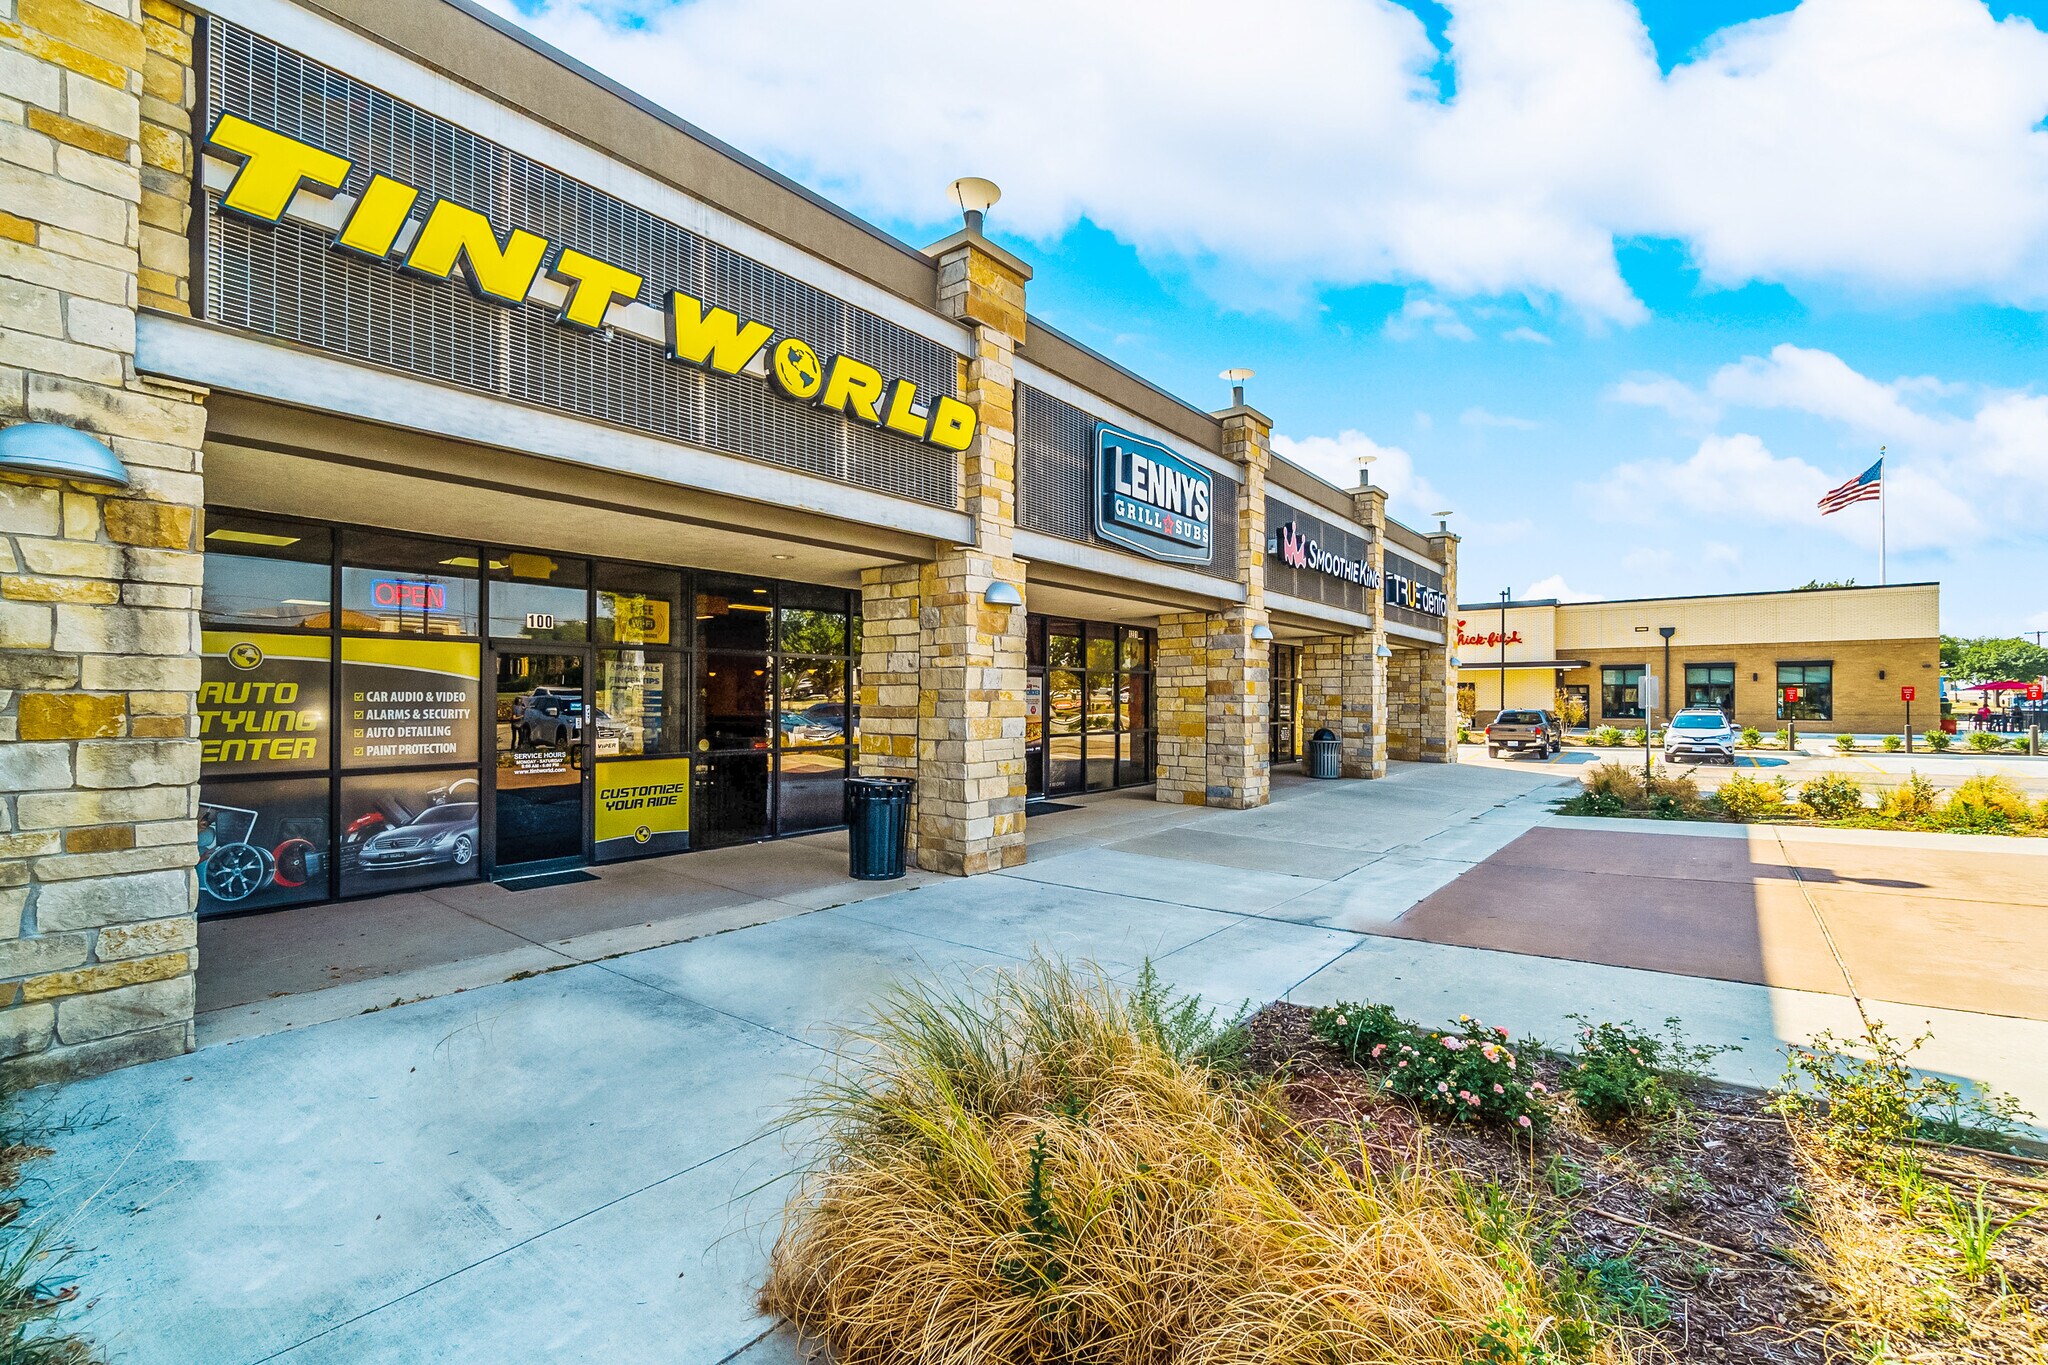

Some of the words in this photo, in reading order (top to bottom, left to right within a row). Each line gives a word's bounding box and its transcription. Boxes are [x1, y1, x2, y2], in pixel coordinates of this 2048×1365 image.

[204, 110, 645, 333] TINT
[668, 289, 977, 451] WORLD
[1115, 446, 1209, 522] LENNYS
[1115, 499, 1162, 529] GRILL
[1175, 520, 1208, 543] SUBS
[1308, 540, 1359, 583] SMOOTHIE
[376, 583, 443, 608] OPEN
[1394, 574, 1421, 609] TRUE
[528, 615, 552, 628] 100
[1457, 620, 1522, 647] hick-fil-A
[198, 682, 298, 704] AUTO
[366, 691, 388, 702] CAR
[390, 691, 423, 702] AUDIO
[426, 691, 434, 702] &
[436, 691, 466, 702] VIDEO
[198, 710, 318, 733] TYLING
[366, 709, 411, 720] ALARMS
[412, 708, 421, 719] &
[423, 708, 470, 719] SECURITY
[366, 727, 395, 738] AUTO
[398, 726, 451, 737] DETAILING
[202, 737, 317, 762] ENTER
[366, 745, 397, 756] PAINT
[399, 743, 457, 755] PROTECTION
[600, 783, 684, 800] CUSTOMIZE
[606, 798, 643, 811] YOUR
[647, 795, 678, 808] RIDE
